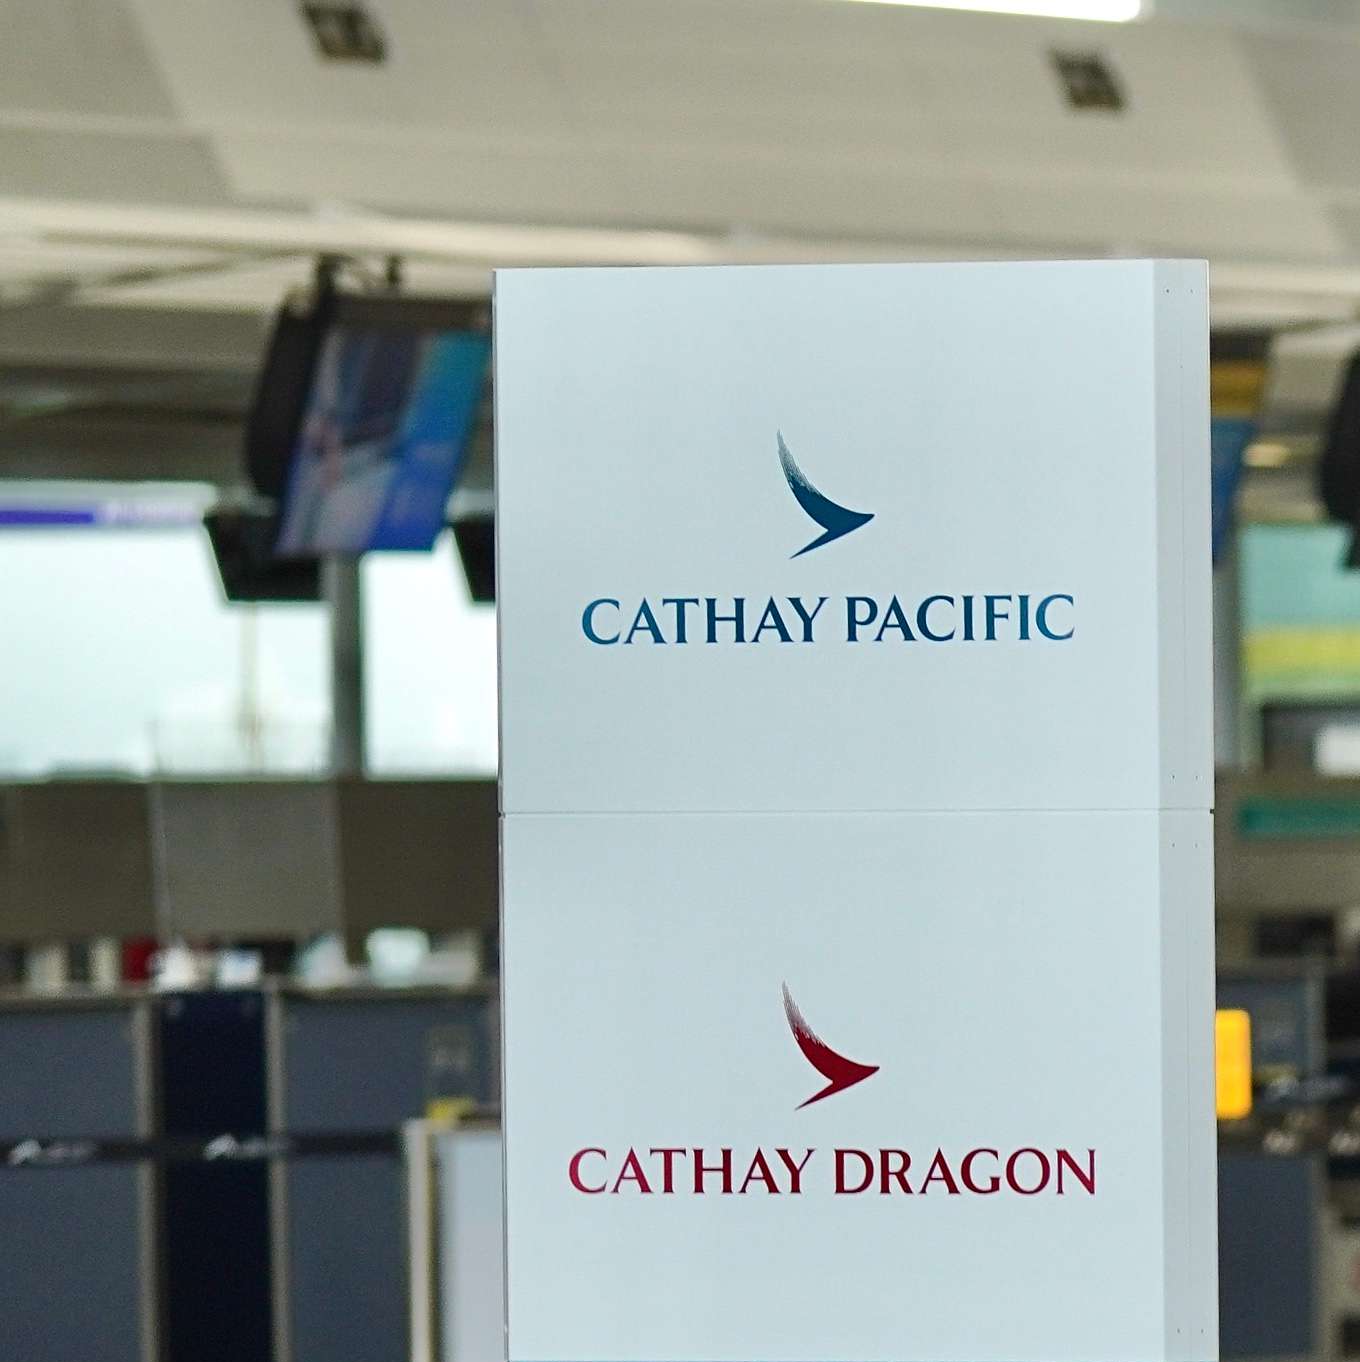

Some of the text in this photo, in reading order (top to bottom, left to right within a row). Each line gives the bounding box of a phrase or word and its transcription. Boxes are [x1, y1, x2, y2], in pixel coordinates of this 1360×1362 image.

[582, 594, 1076, 645] CATHAY PACIFIC
[568, 1147, 1097, 1196] CATHAY DRAGON
